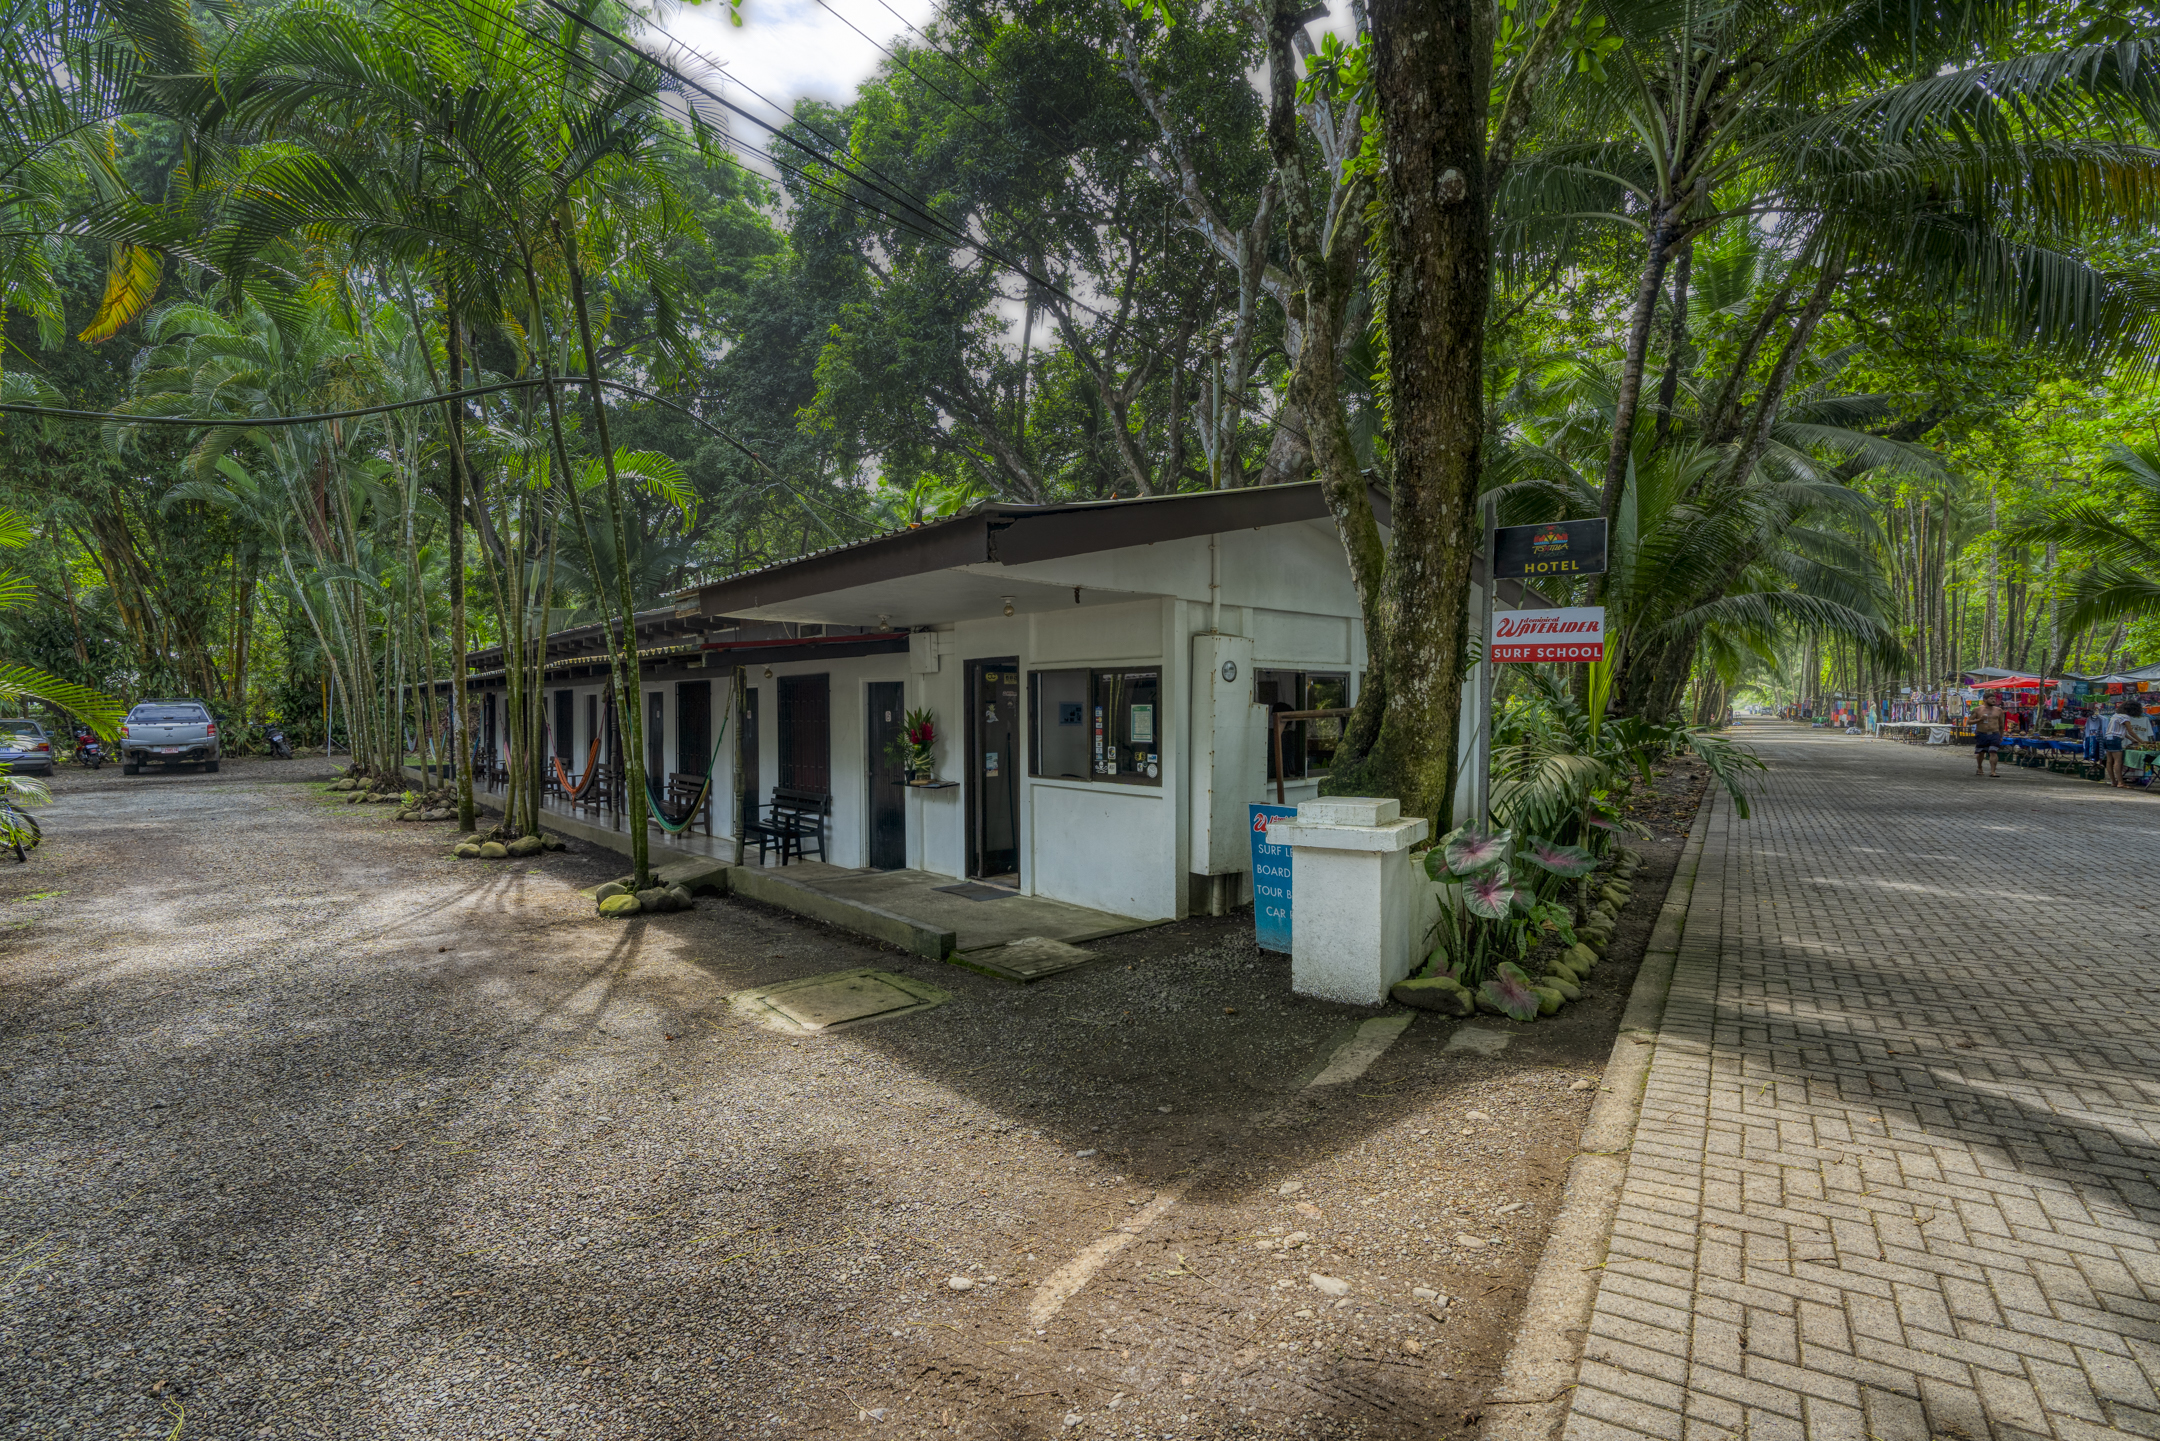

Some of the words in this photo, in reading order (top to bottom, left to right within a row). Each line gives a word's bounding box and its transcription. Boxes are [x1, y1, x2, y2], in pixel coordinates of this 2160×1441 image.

[1524, 560, 1579, 573] HOTEL
[1494, 648, 1531, 658] SURF
[1537, 647, 1601, 658] SCHOOL
[1258, 844, 1281, 856] SURF
[1256, 864, 1291, 878] BOARD
[1256, 884, 1283, 898] TOUR
[1265, 906, 1286, 919] CAR
